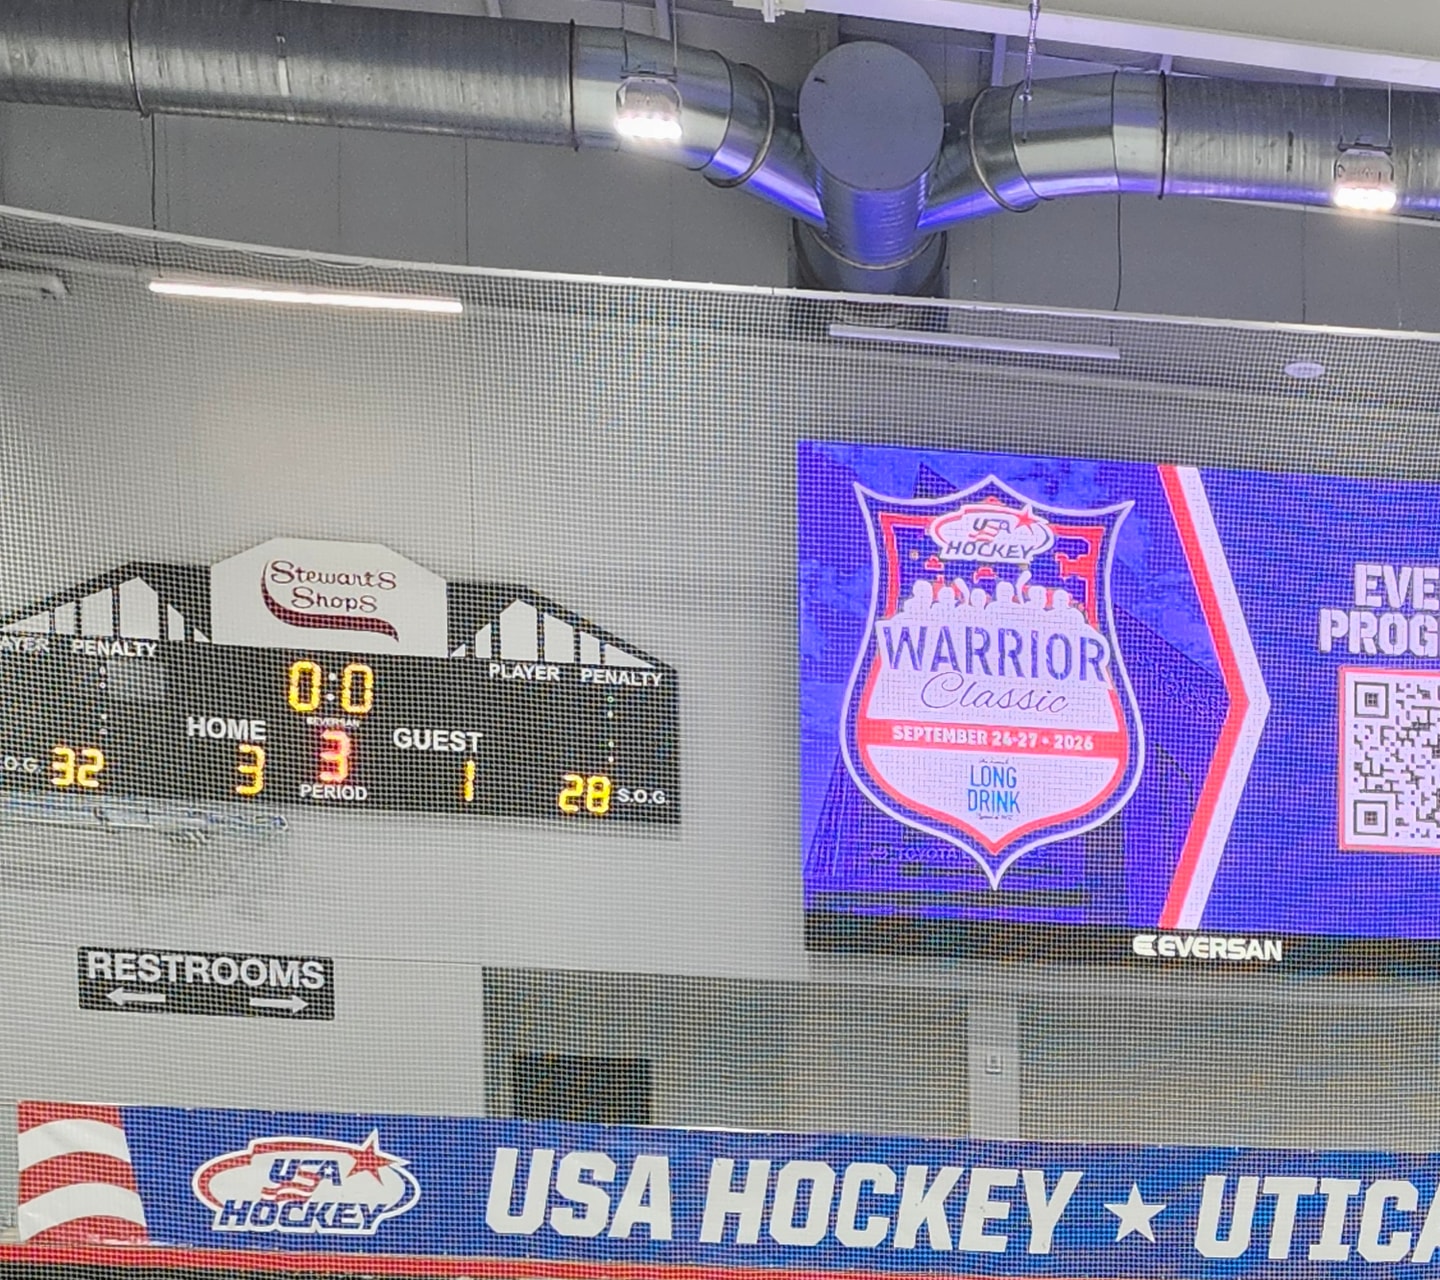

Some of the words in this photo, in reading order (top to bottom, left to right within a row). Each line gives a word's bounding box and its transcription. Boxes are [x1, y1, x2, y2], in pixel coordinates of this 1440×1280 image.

[946, 541, 1034, 560] HOCKEY
[291, 587, 378, 613] Shops
[71, 639, 157, 657] PENALTY
[883, 626, 1106, 682] WARRIOR
[288, 660, 374, 714] 0:0
[489, 664, 560, 682] PLAYER
[580, 669, 662, 688] PENALTY
[921, 671, 1069, 714] Classic
[186, 716, 267, 742] HOME
[392, 729, 483, 754] GUEST
[892, 725, 988, 745] SEPTEMBER
[1054, 734, 1094, 750] 2026
[50, 745, 105, 789] 32
[236, 743, 266, 796] 3
[319, 729, 350, 783] 3
[463, 760, 476, 802] 1
[971, 765, 1017, 788] LONG
[300, 784, 367, 801] PERIOD
[558, 774, 612, 814] 28
[968, 789, 1020, 813] DRINK
[86, 951, 325, 990] RESTROOMS
[269, 1158, 341, 1189] USA
[217, 1198, 384, 1230] HOCKEY
[485, 1147, 673, 1241] USA
[700, 1157, 1084, 1255] HOCKEY
